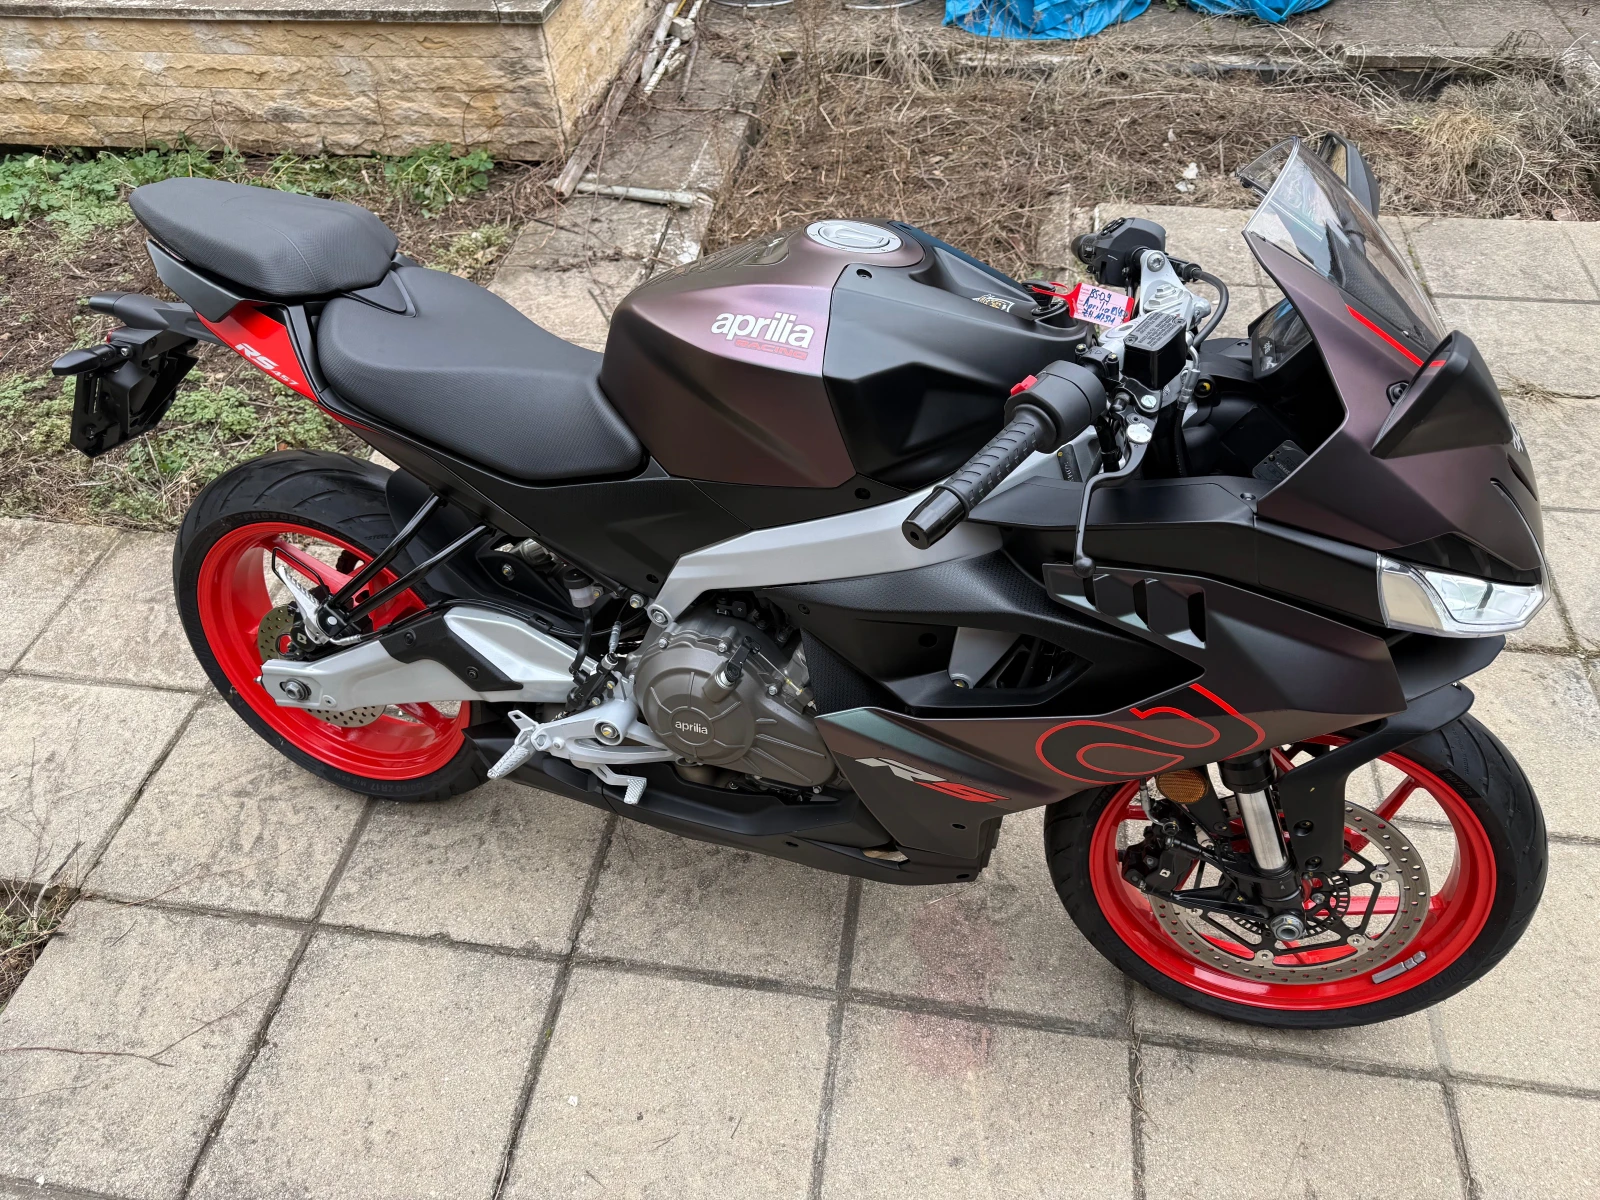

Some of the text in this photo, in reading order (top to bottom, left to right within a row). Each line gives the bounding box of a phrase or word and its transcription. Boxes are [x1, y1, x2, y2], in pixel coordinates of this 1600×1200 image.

[710, 311, 815, 349] aprilia
[235, 342, 279, 370] RS
[735, 338, 808, 361] RACING
[675, 721, 708, 735] aprilia
[855, 757, 1010, 803] RS
